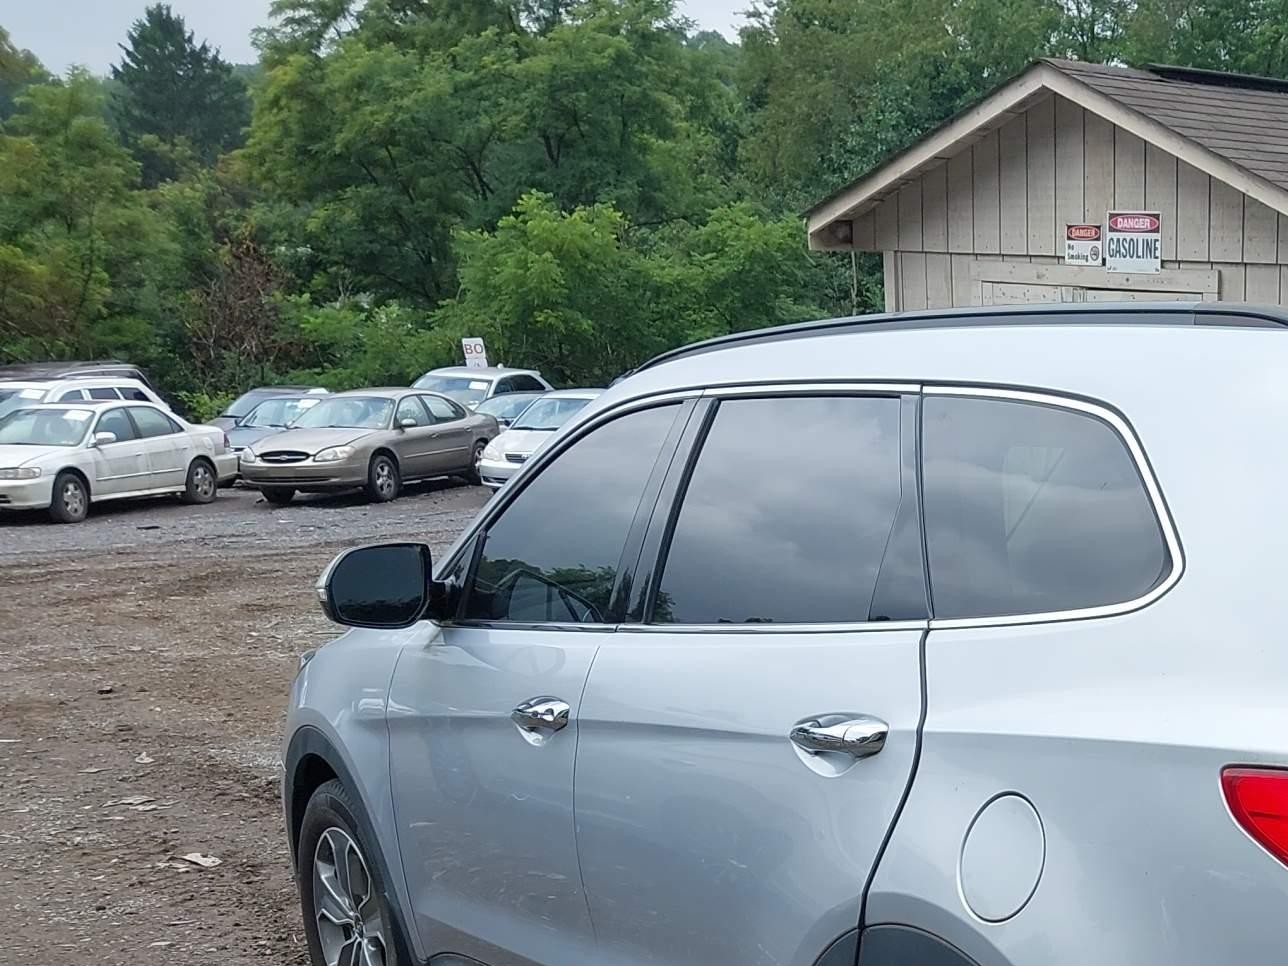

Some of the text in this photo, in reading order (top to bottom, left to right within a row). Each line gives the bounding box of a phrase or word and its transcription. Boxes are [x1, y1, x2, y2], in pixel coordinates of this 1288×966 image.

[1117, 218, 1150, 229] DANGER
[1071, 228, 1095, 237] DANGER
[1108, 238, 1160, 259] GASOLINE
[1067, 251, 1089, 263] Smoking
[464, 343, 484, 355] BO
